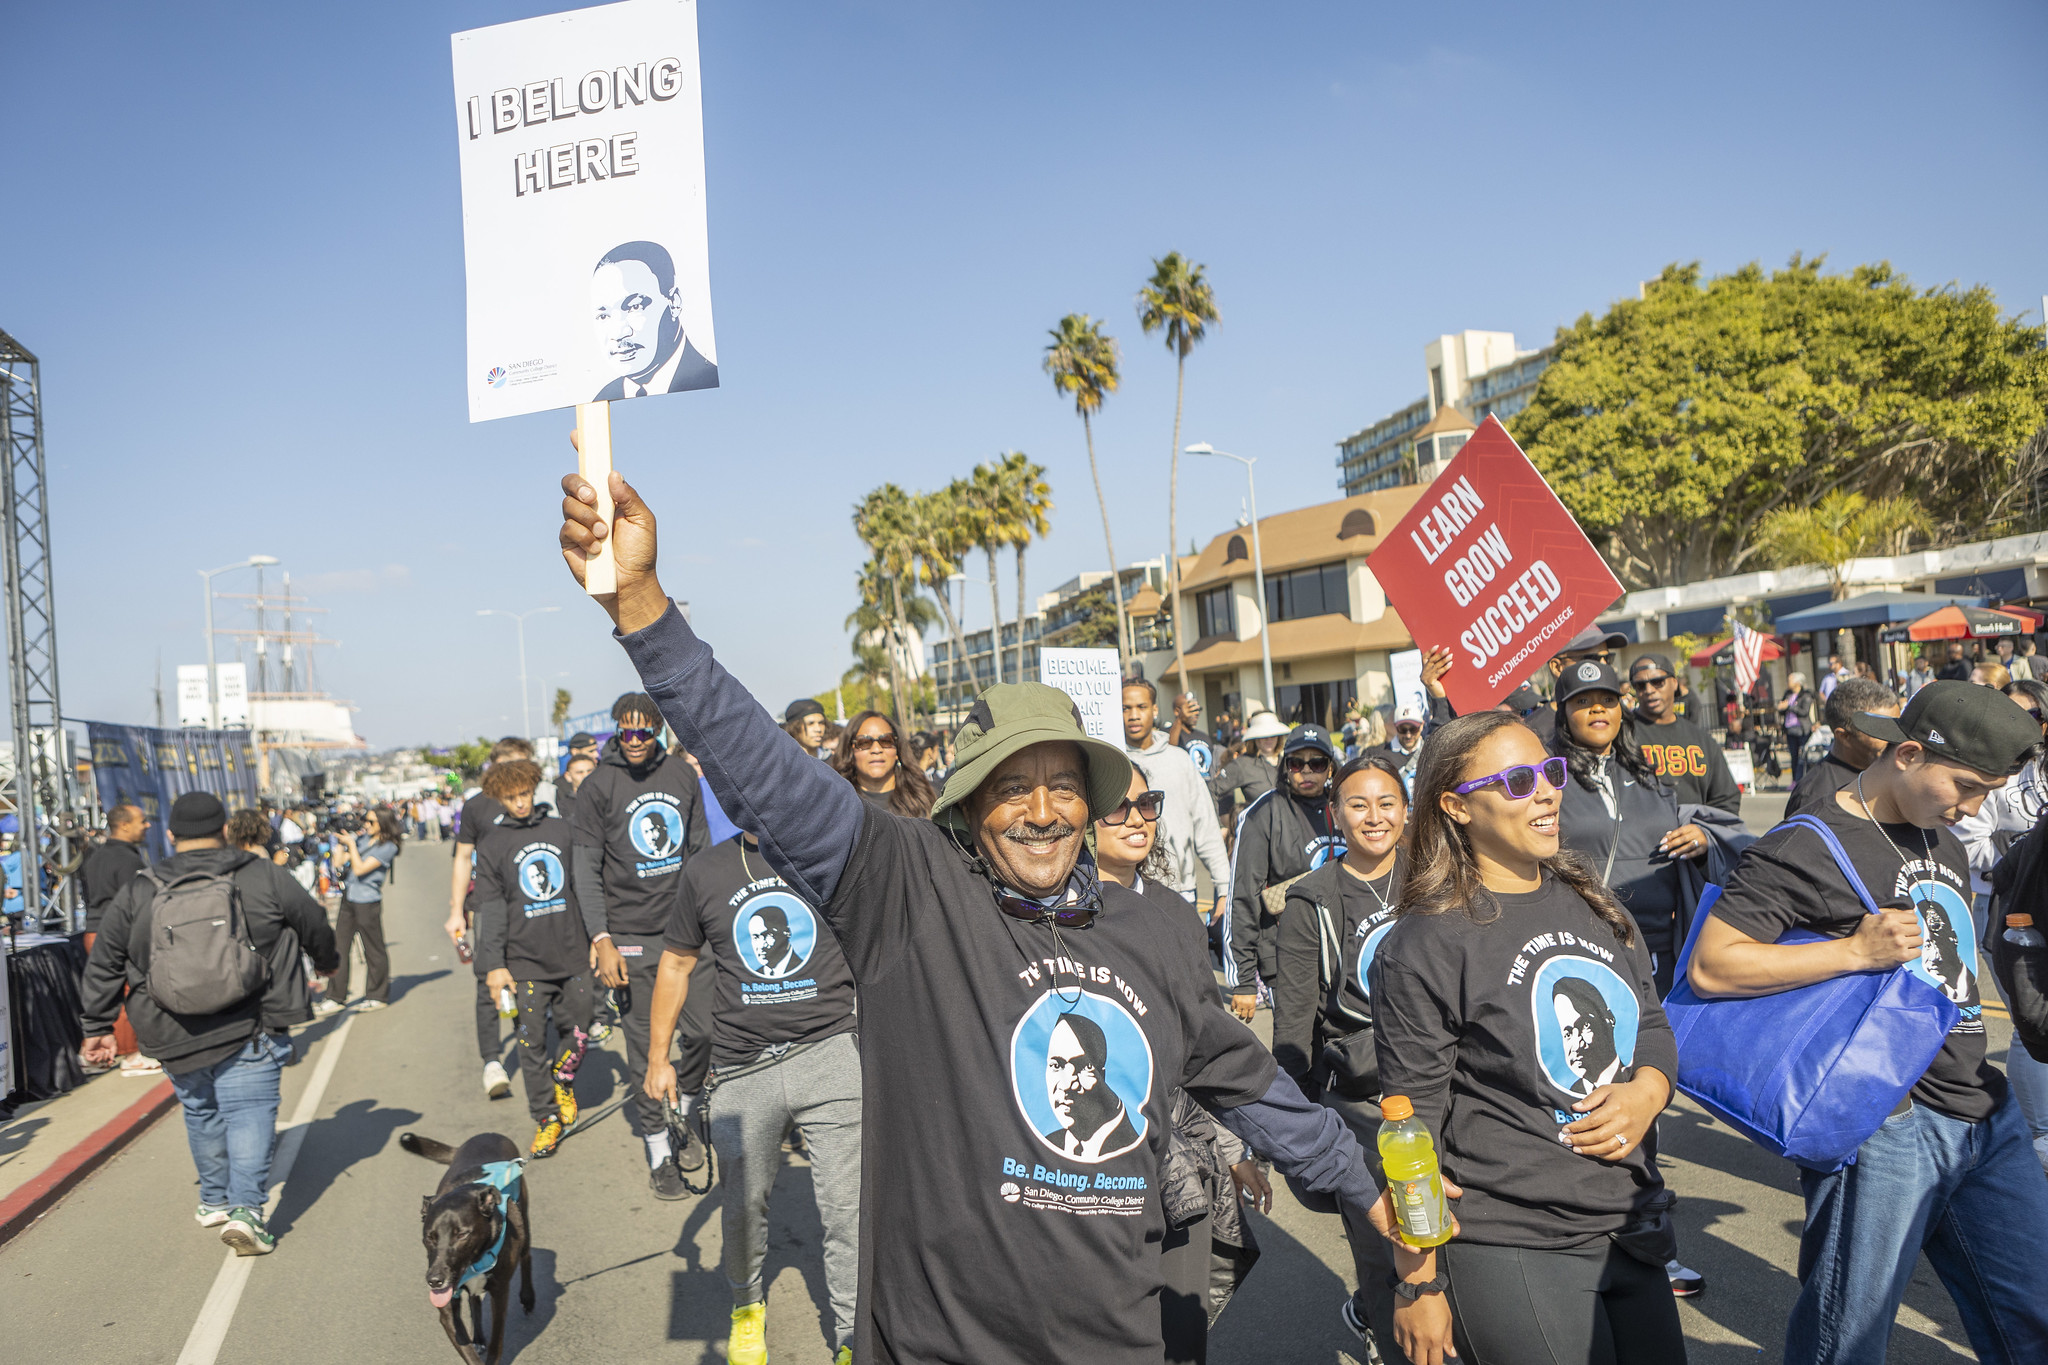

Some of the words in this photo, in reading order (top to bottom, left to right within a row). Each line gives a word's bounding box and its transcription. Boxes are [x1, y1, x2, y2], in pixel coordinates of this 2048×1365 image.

[467, 95, 481, 140] I
[491, 56, 683, 134] BELONG
[514, 131, 639, 197] HERE
[522, 358, 544, 368] DIEGO
[1410, 474, 1485, 565] LEARN
[1444, 522, 1513, 607] GROW
[1460, 559, 1562, 669] SUCCEED
[1488, 668, 1506, 688] SAN
[1503, 648, 1528, 675] DIEGO
[1526, 633, 1543, 653] CITY
[1541, 605, 1574, 640] COLLEGE
[1047, 658, 1117, 675] BECOME...
[1085, 680, 1113, 695] YOU
[1078, 701, 1103, 715] ANT
[1087, 721, 1104, 735] BE
[1641, 744, 1707, 776] USC
[1939, 863, 1963, 888] NOW
[728, 887, 749, 907] THE
[747, 877, 776, 892] TIME
[1355, 918, 1371, 938] THE
[1507, 954, 1530, 985] THE
[1522, 932, 1557, 956] TIME
[1557, 931, 1576, 946] IS
[1577, 936, 1614, 963] NOW
[752, 982, 783, 993] Belong.
[782, 978, 817, 990] Become.
[1089, 966, 1111, 984] IS
[1114, 975, 1148, 1017] NOW
[1002, 1157, 1030, 1179] Be.
[1032, 1163, 1091, 1192] Belong.
[1093, 1172, 1148, 1190] Become.
[1024, 1186, 1038, 1197] San
[1039, 1187, 1063, 1202] Diego
[1064, 1194, 1101, 1206] Community
[1100, 1195, 1124, 1207] College
[1124, 1196, 1145, 1205] District
